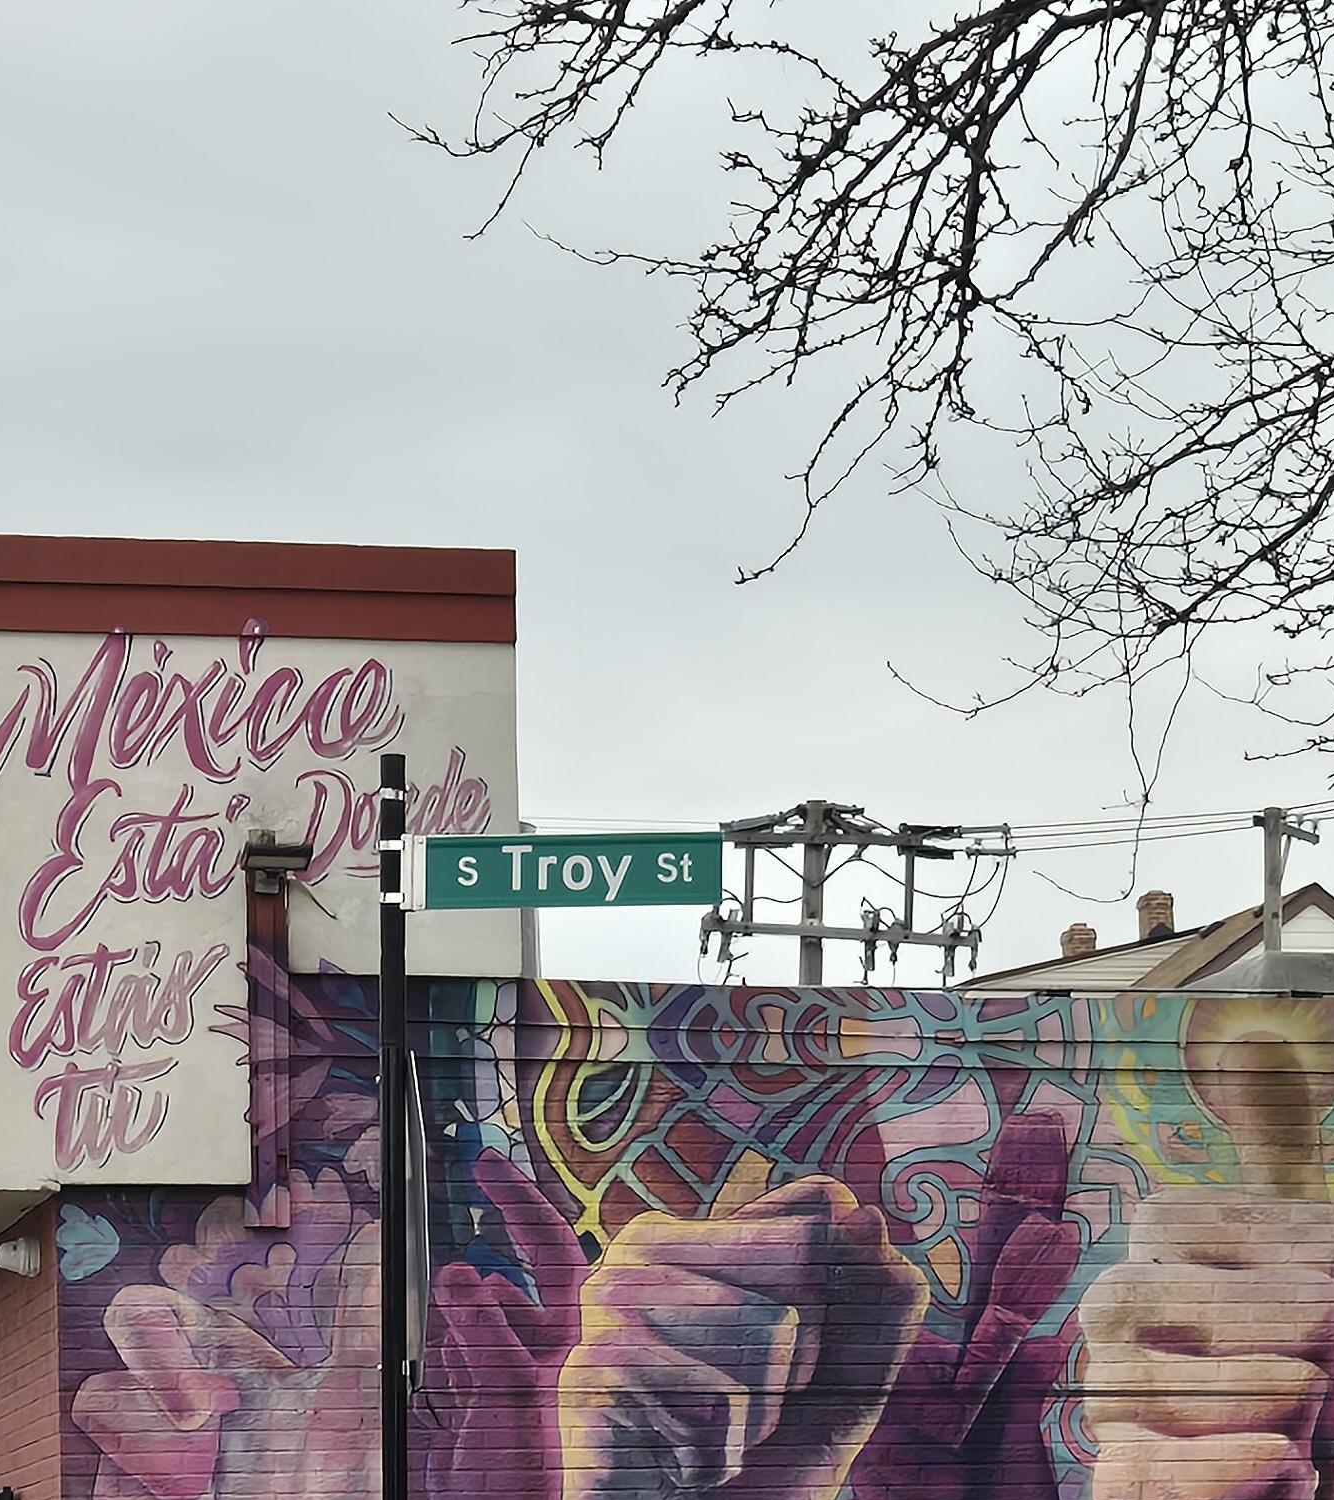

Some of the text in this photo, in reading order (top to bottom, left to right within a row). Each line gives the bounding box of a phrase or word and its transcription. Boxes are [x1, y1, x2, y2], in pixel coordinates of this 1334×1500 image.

[295, 745, 491, 886] Dode
[501, 844, 633, 902] Troy
[656, 852, 693, 884] St
